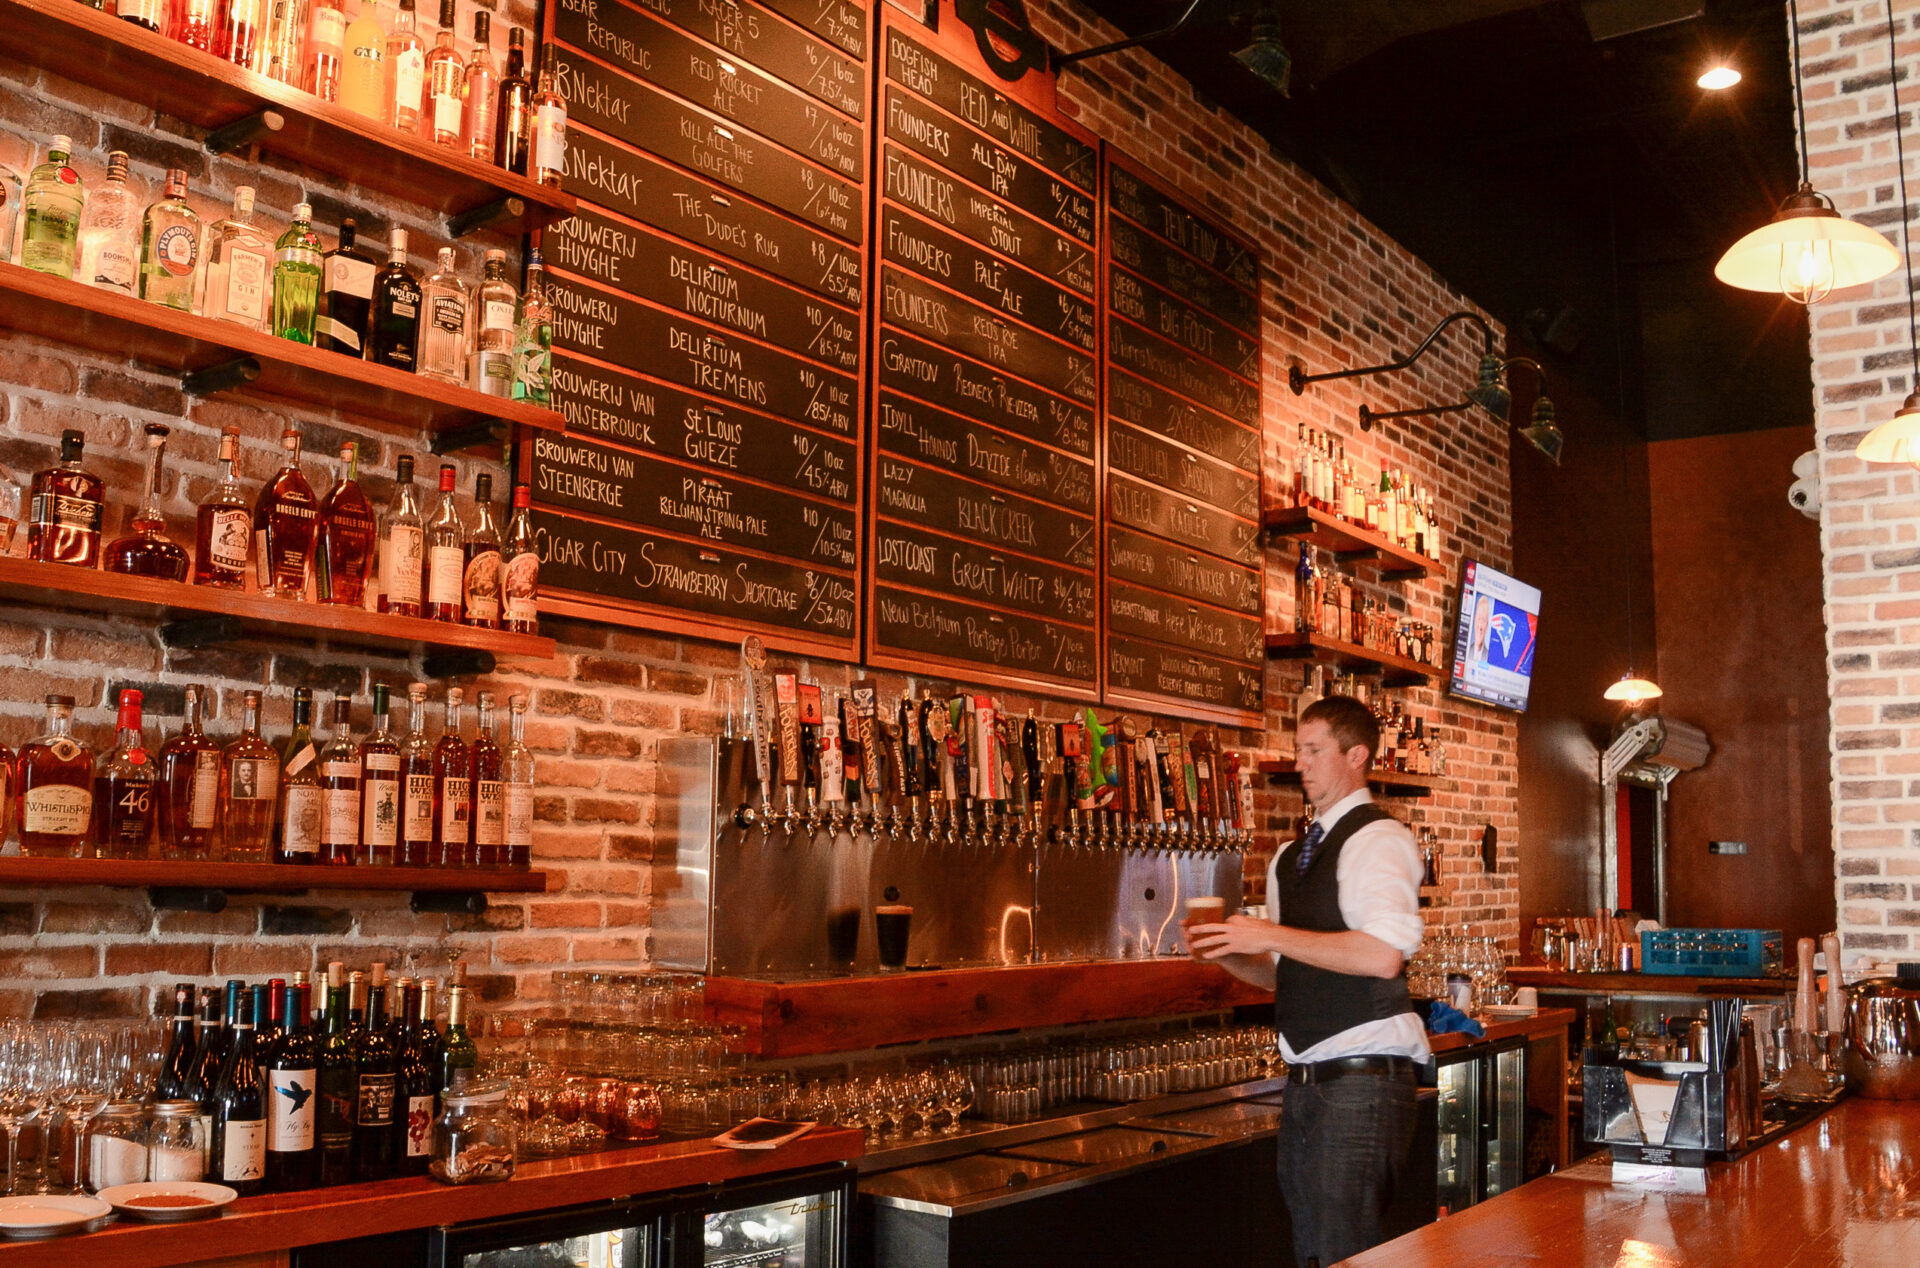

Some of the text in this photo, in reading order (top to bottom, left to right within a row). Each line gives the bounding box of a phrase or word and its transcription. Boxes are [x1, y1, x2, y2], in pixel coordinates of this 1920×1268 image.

[587, 20, 652, 70] REPUBLIC
[716, 21, 744, 54] IPA
[749, 16, 760, 39] 5
[690, 55, 763, 105] RED ROCKET
[891, 37, 938, 81] DOGFISH
[902, 62, 932, 95] HEAD
[557, 60, 631, 125] B.Nektar
[713, 90, 736, 115] ALE
[680, 116, 754, 166] KILL ALL THE
[890, 98, 950, 157] FOUNDERS
[960, 80, 988, 128] RED
[1008, 109, 1044, 161] WHITE
[692, 146, 744, 184] GOLFERS
[972, 143, 1016, 181] ALL DAY
[673, 192, 703, 218] THE
[887, 156, 956, 225] FOUNDERS
[992, 172, 1009, 196] IPA
[970, 197, 1015, 232] IMPERIAL
[159, 226, 194, 249] PLYMOUTH
[558, 236, 621, 282] HUYGHE
[706, 214, 780, 263] DUDE'S RUG
[889, 219, 952, 278] FOUNDERS
[990, 225, 1022, 256] STOUT
[670, 256, 739, 300] DELIRIUM
[975, 260, 1023, 316] PALE ALE
[545, 281, 617, 326] BROUWERIJ
[685, 286, 766, 337] NOCTURNUM
[886, 285, 949, 336] FOUNDERS
[552, 312, 604, 349] HUYGHE
[670, 326, 742, 371] DELIRIUM
[689, 358, 767, 405] TREMENS
[883, 340, 938, 383] GRAYTON
[549, 367, 655, 417] ROUWERIJ VAN
[550, 392, 655, 444] HONSEBROUCK
[707, 417, 742, 445] LOUIS
[881, 404, 957, 464] IDYLL HOUNDS
[535, 438, 634, 479] BROUWERIJ VAN
[685, 433, 738, 468] GUEZE
[967, 433, 1011, 477] DIVIDE
[538, 464, 624, 507] STEENBERGE
[683, 477, 733, 510] PIRAAT
[883, 462, 914, 484] LAZY
[660, 496, 768, 536] BELGIAN STRONG PALE
[882, 486, 927, 514] MAGNOLIA
[958, 496, 1037, 547] BLACK CREEK
[701, 523, 723, 540] ALE
[536, 527, 798, 611] CIGAR CITY STRAWBERRY SHORTCAKE
[119, 789, 149, 814] 46
[410, 777, 432, 787] HIG
[448, 781, 470, 791] HIG
[481, 783, 500, 793] HIG
